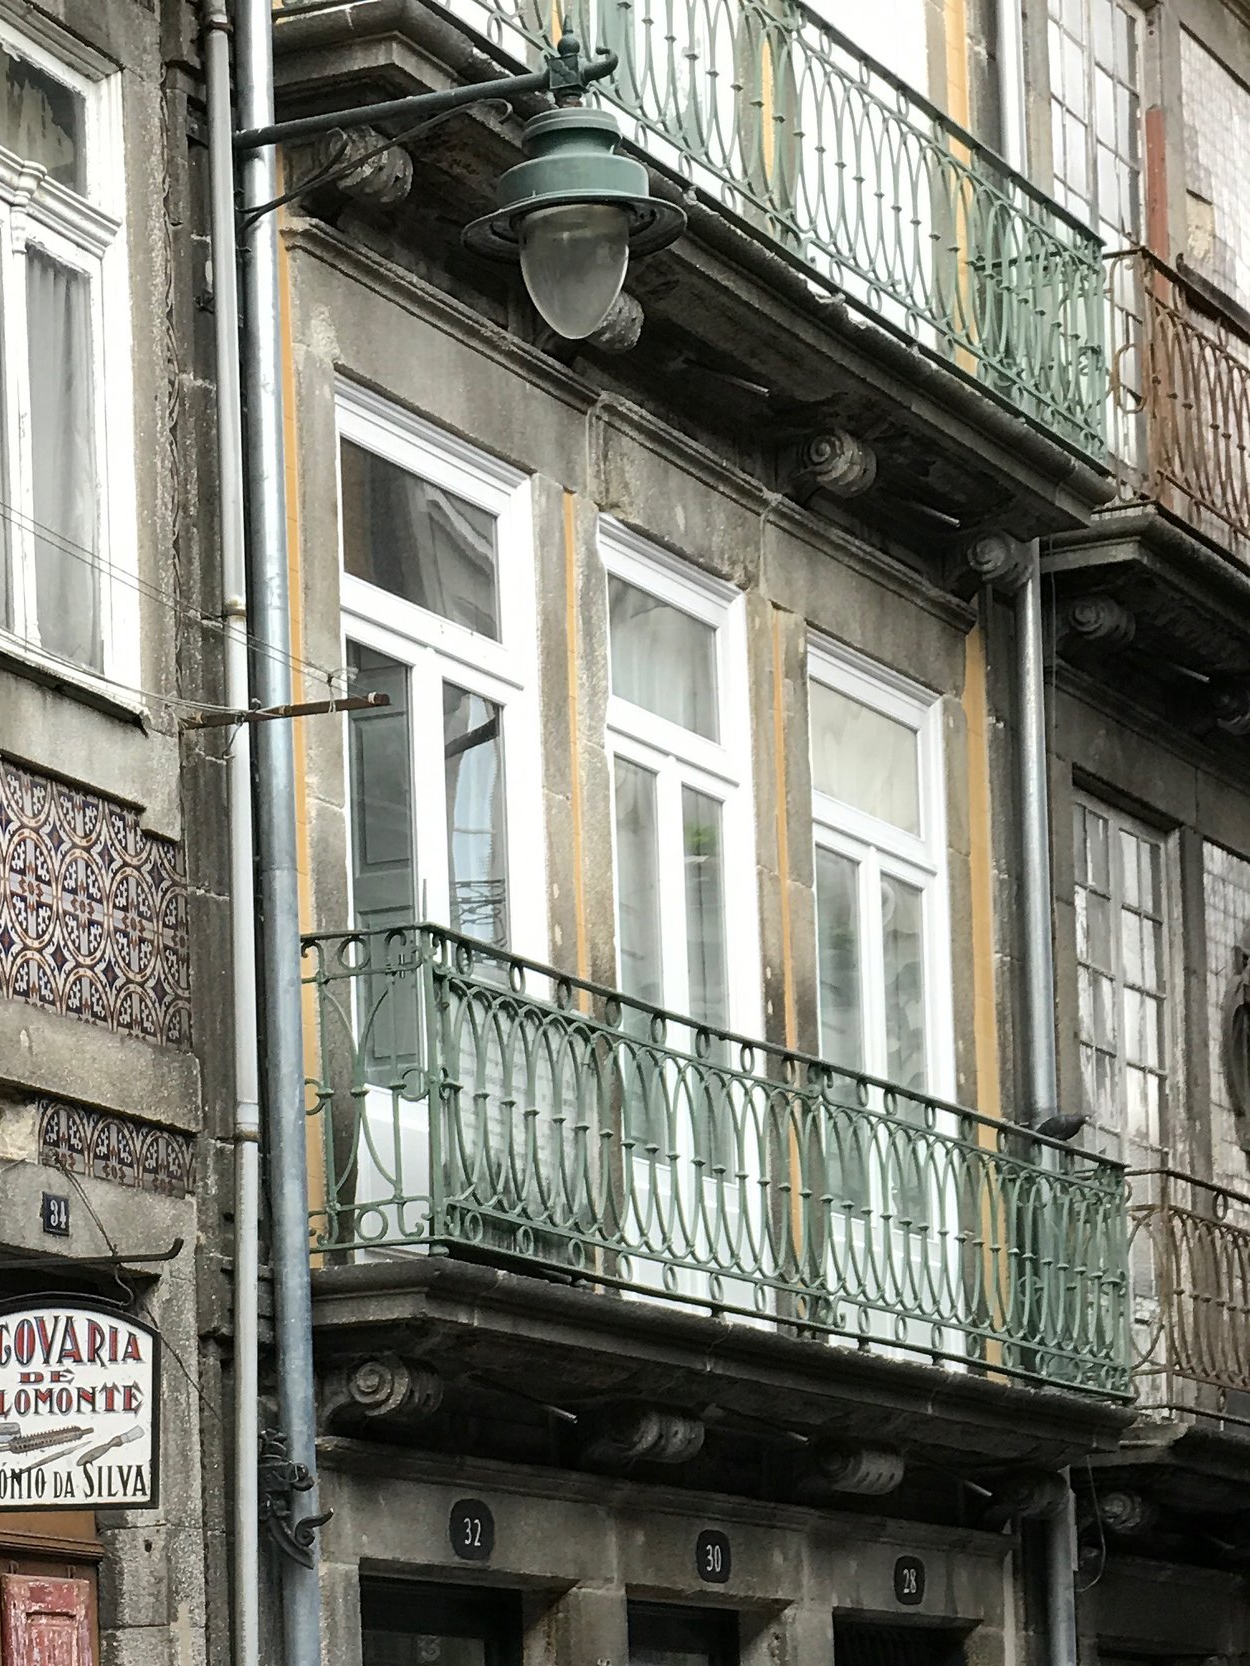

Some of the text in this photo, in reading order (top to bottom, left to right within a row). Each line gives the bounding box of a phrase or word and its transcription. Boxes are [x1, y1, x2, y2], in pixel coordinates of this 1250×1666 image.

[50, 1200, 67, 1229] 34
[19, 1368, 75, 1386] DE
[53, 1470, 75, 1498] DA
[82, 1461, 148, 1499] SILVA
[463, 1517, 482, 1547] 32
[706, 1544, 722, 1573] 30
[903, 1568, 917, 1594] 28
